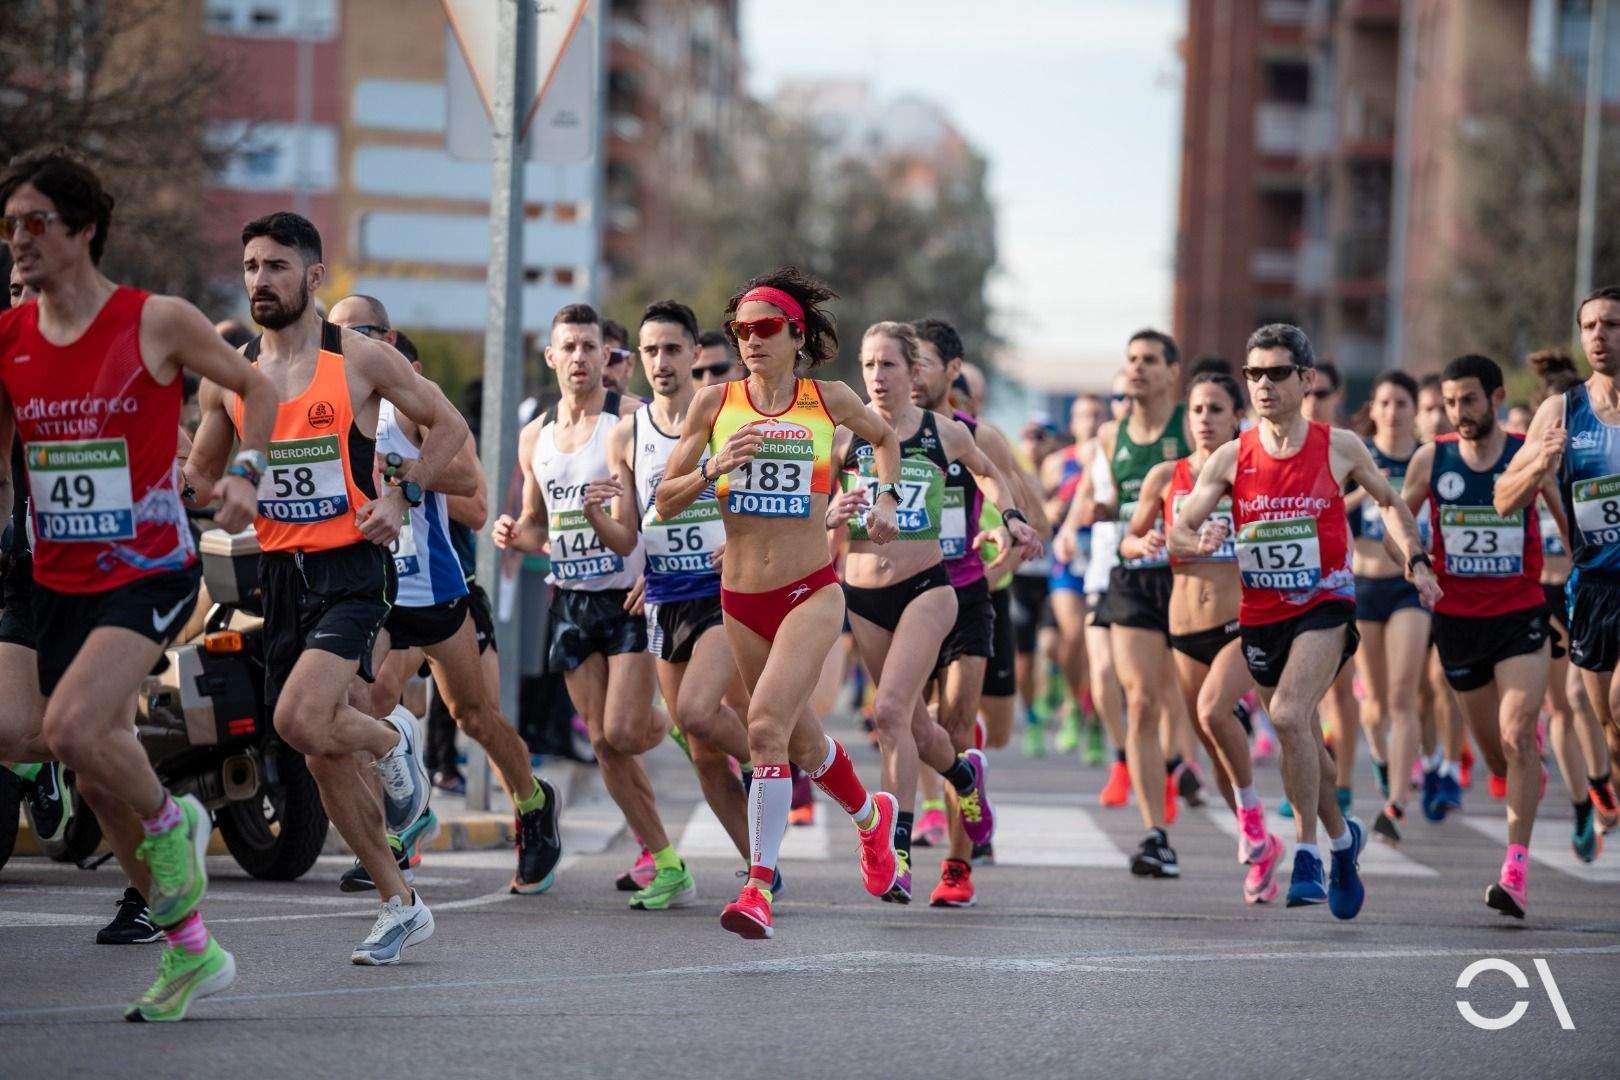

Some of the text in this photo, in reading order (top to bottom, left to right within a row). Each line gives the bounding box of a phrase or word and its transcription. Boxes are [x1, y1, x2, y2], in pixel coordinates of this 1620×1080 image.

[15, 392, 138, 420] editerránea
[35, 417, 98, 435] ATTICUS
[762, 429, 806, 439] rrano
[48, 449, 121, 466] IBERDROLA
[270, 445, 335, 460] IBERDROLA
[755, 443, 813, 455] BERDROLA
[272, 466, 316, 498] 58
[740, 462, 801, 492] 183
[901, 466, 934, 479] DROLA
[50, 474, 95, 509] 49
[667, 526, 703, 553] 56
[1257, 525, 1312, 537] IBERDROLA
[1463, 530, 1498, 553] 23
[557, 532, 606, 559] 144
[1250, 543, 1305, 570] 152
